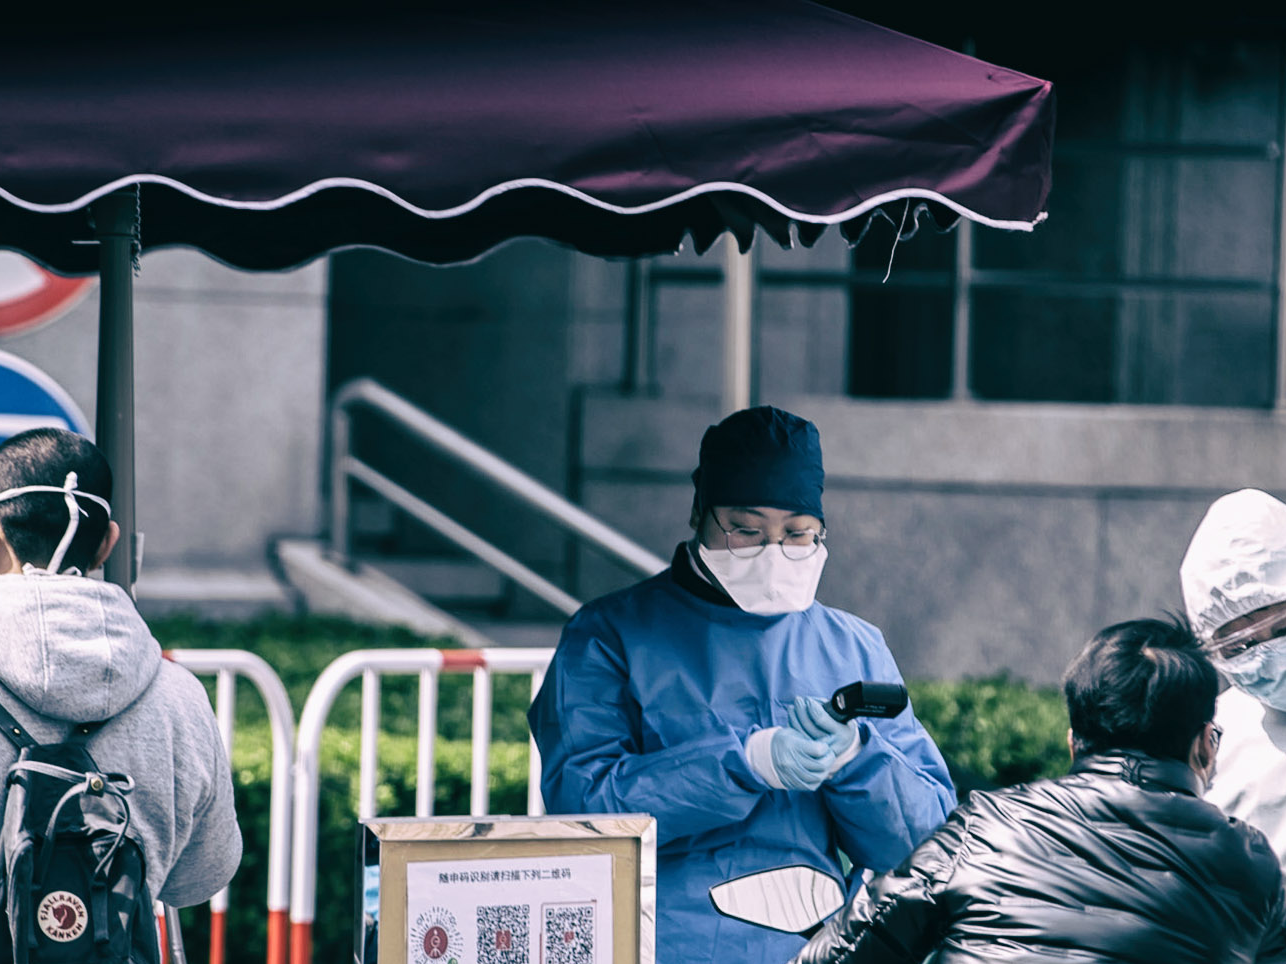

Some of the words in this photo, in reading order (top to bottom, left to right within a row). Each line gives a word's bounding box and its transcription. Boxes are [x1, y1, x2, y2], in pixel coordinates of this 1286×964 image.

[438, 867, 572, 885] 随申码识别请扫描下列二维码
